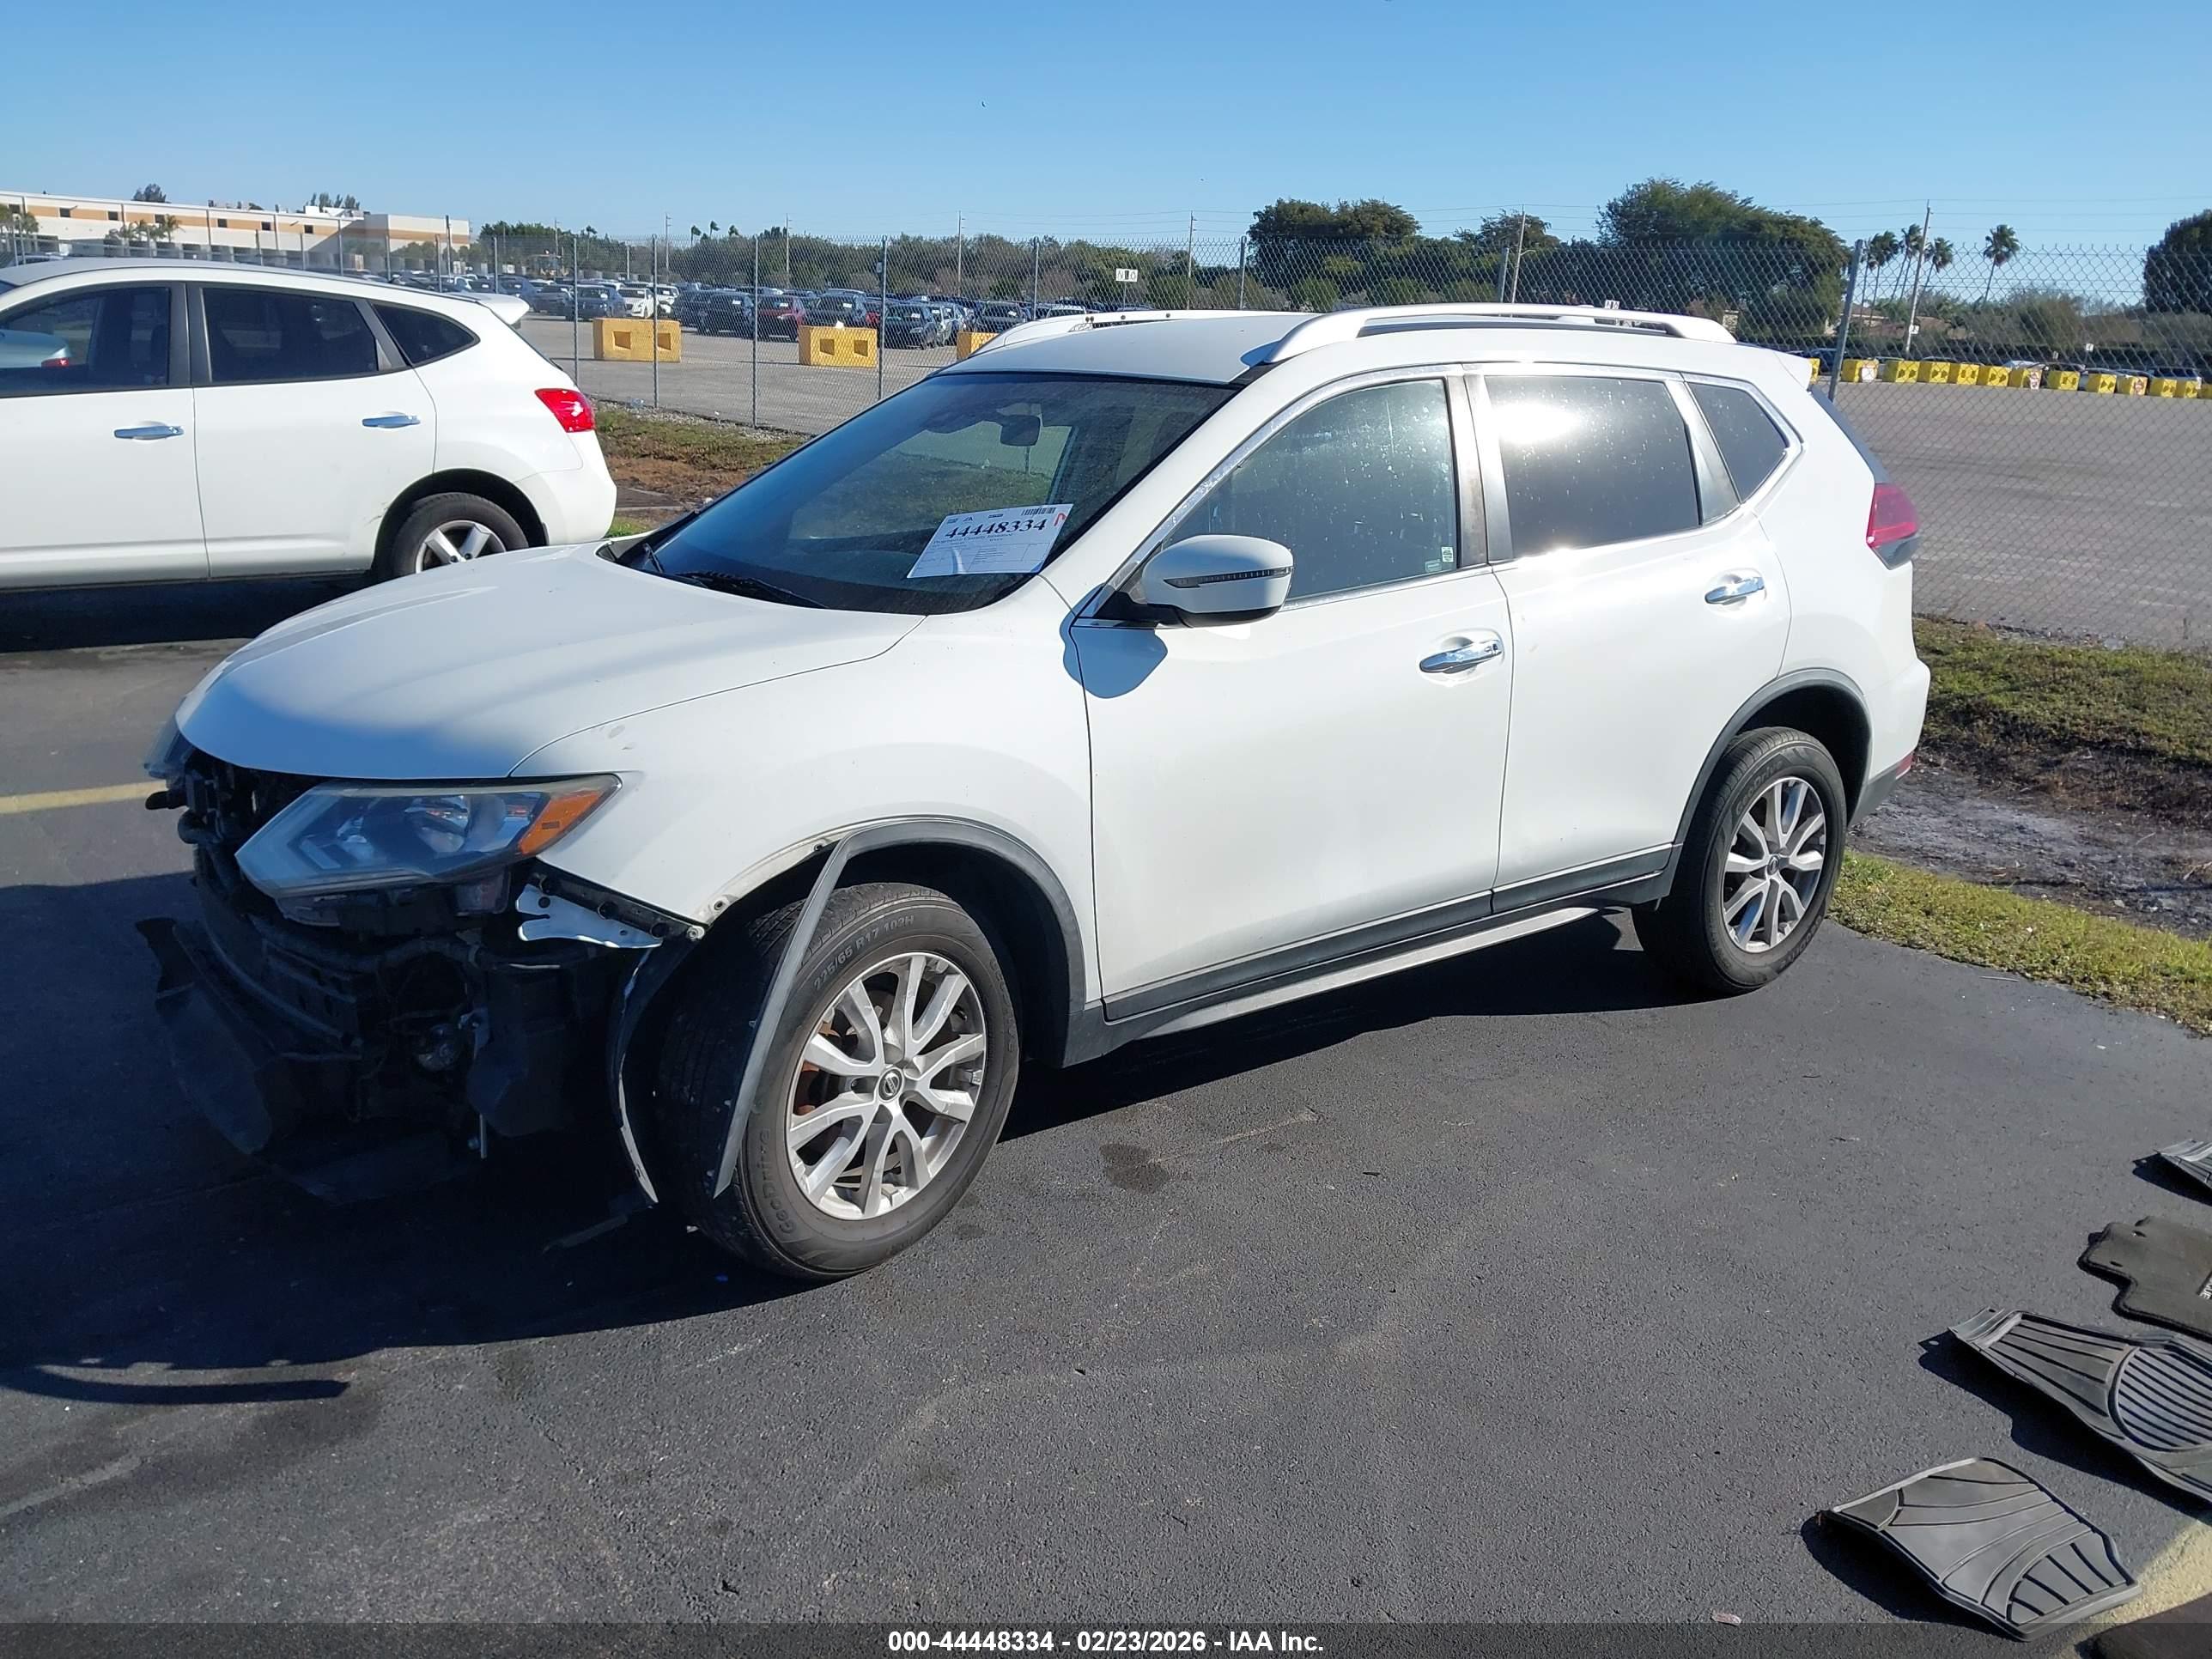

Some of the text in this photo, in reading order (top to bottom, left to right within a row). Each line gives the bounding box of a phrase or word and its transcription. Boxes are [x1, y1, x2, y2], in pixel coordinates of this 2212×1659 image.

[945, 520, 1048, 538] 44448334
[814, 915, 915, 990] 225/65 R17 102H
